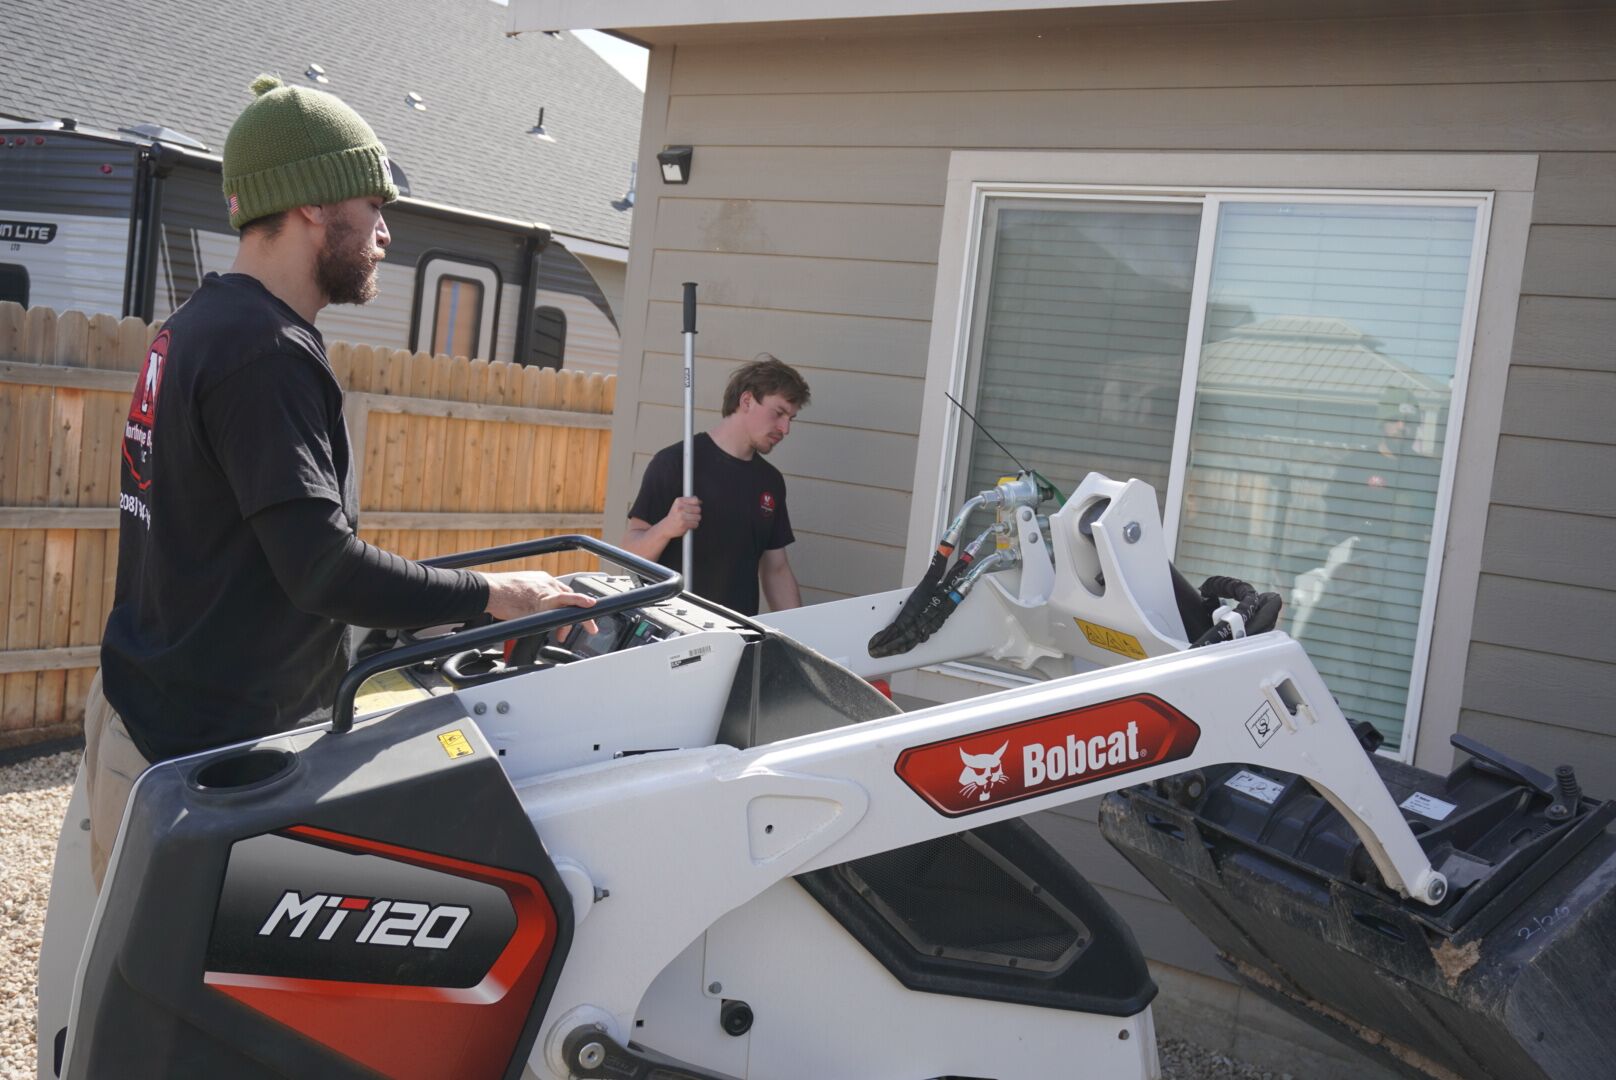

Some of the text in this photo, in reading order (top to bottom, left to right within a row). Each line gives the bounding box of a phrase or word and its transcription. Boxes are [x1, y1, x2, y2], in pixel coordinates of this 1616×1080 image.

[15, 225, 51, 240] LITE
[1022, 720, 1139, 788] Bobcat
[257, 891, 472, 949] MT120
